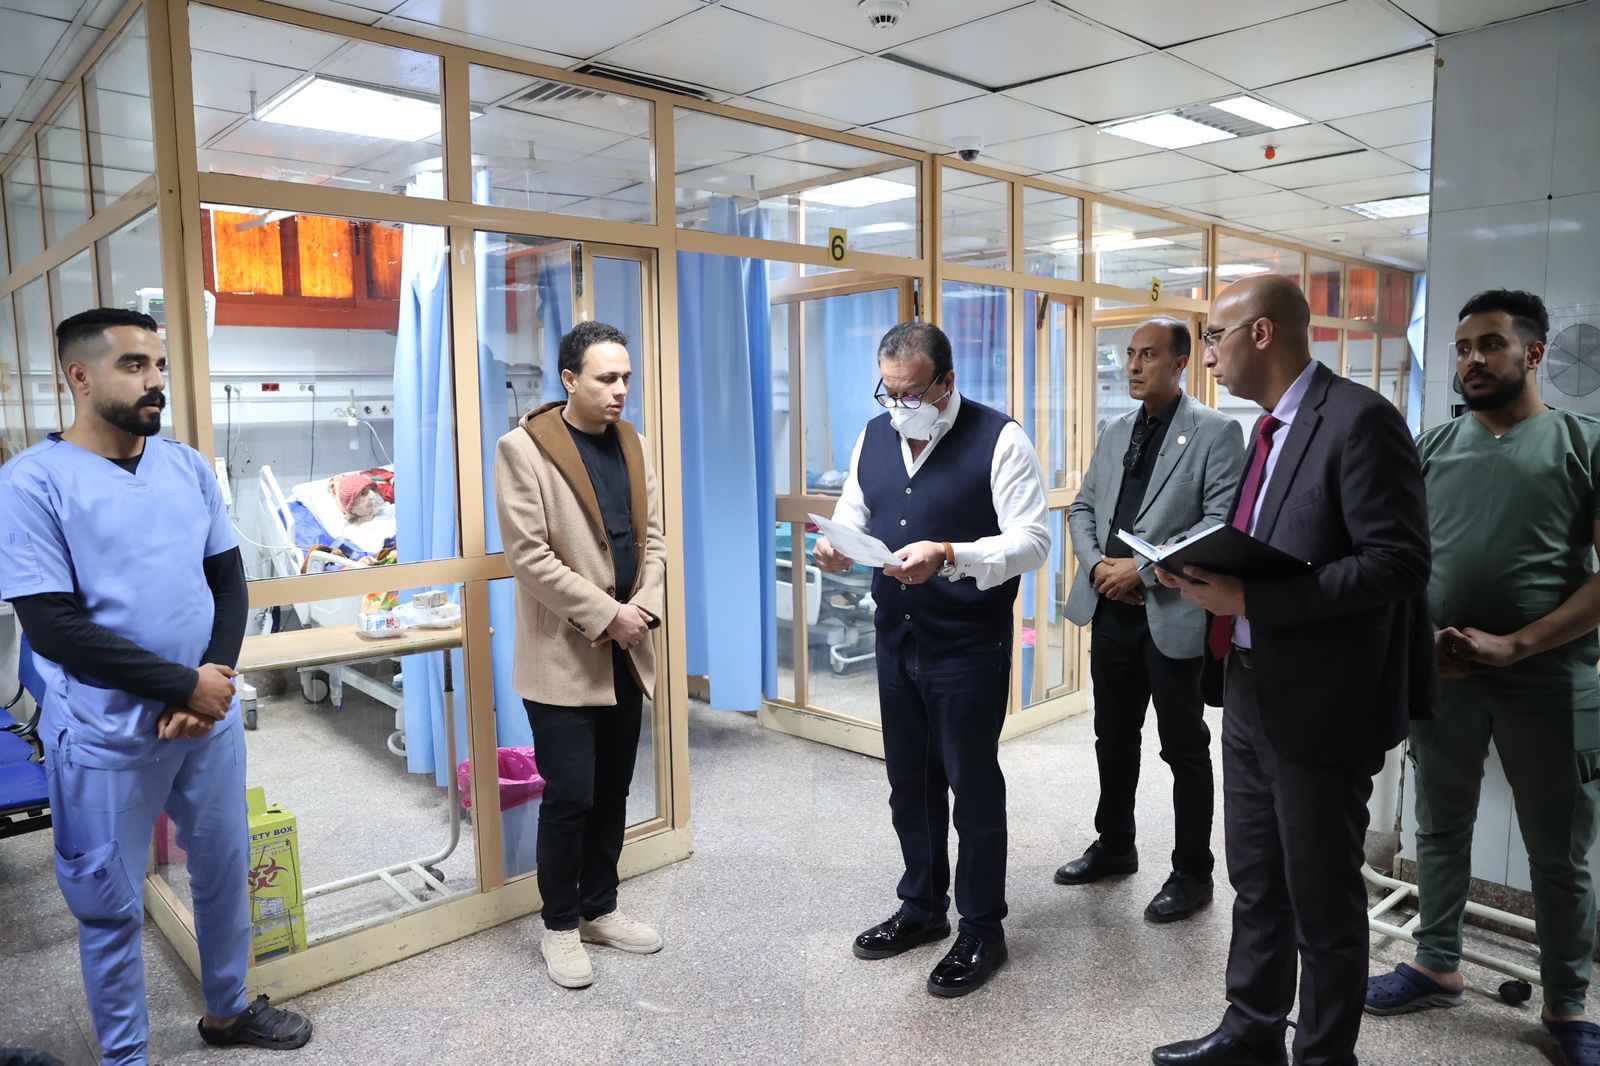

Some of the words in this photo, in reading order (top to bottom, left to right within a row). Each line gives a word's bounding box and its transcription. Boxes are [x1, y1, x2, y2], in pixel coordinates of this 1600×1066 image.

[832, 235, 844, 261] 6
[1152, 283, 1159, 301] 5
[273, 826, 292, 836] BOX
